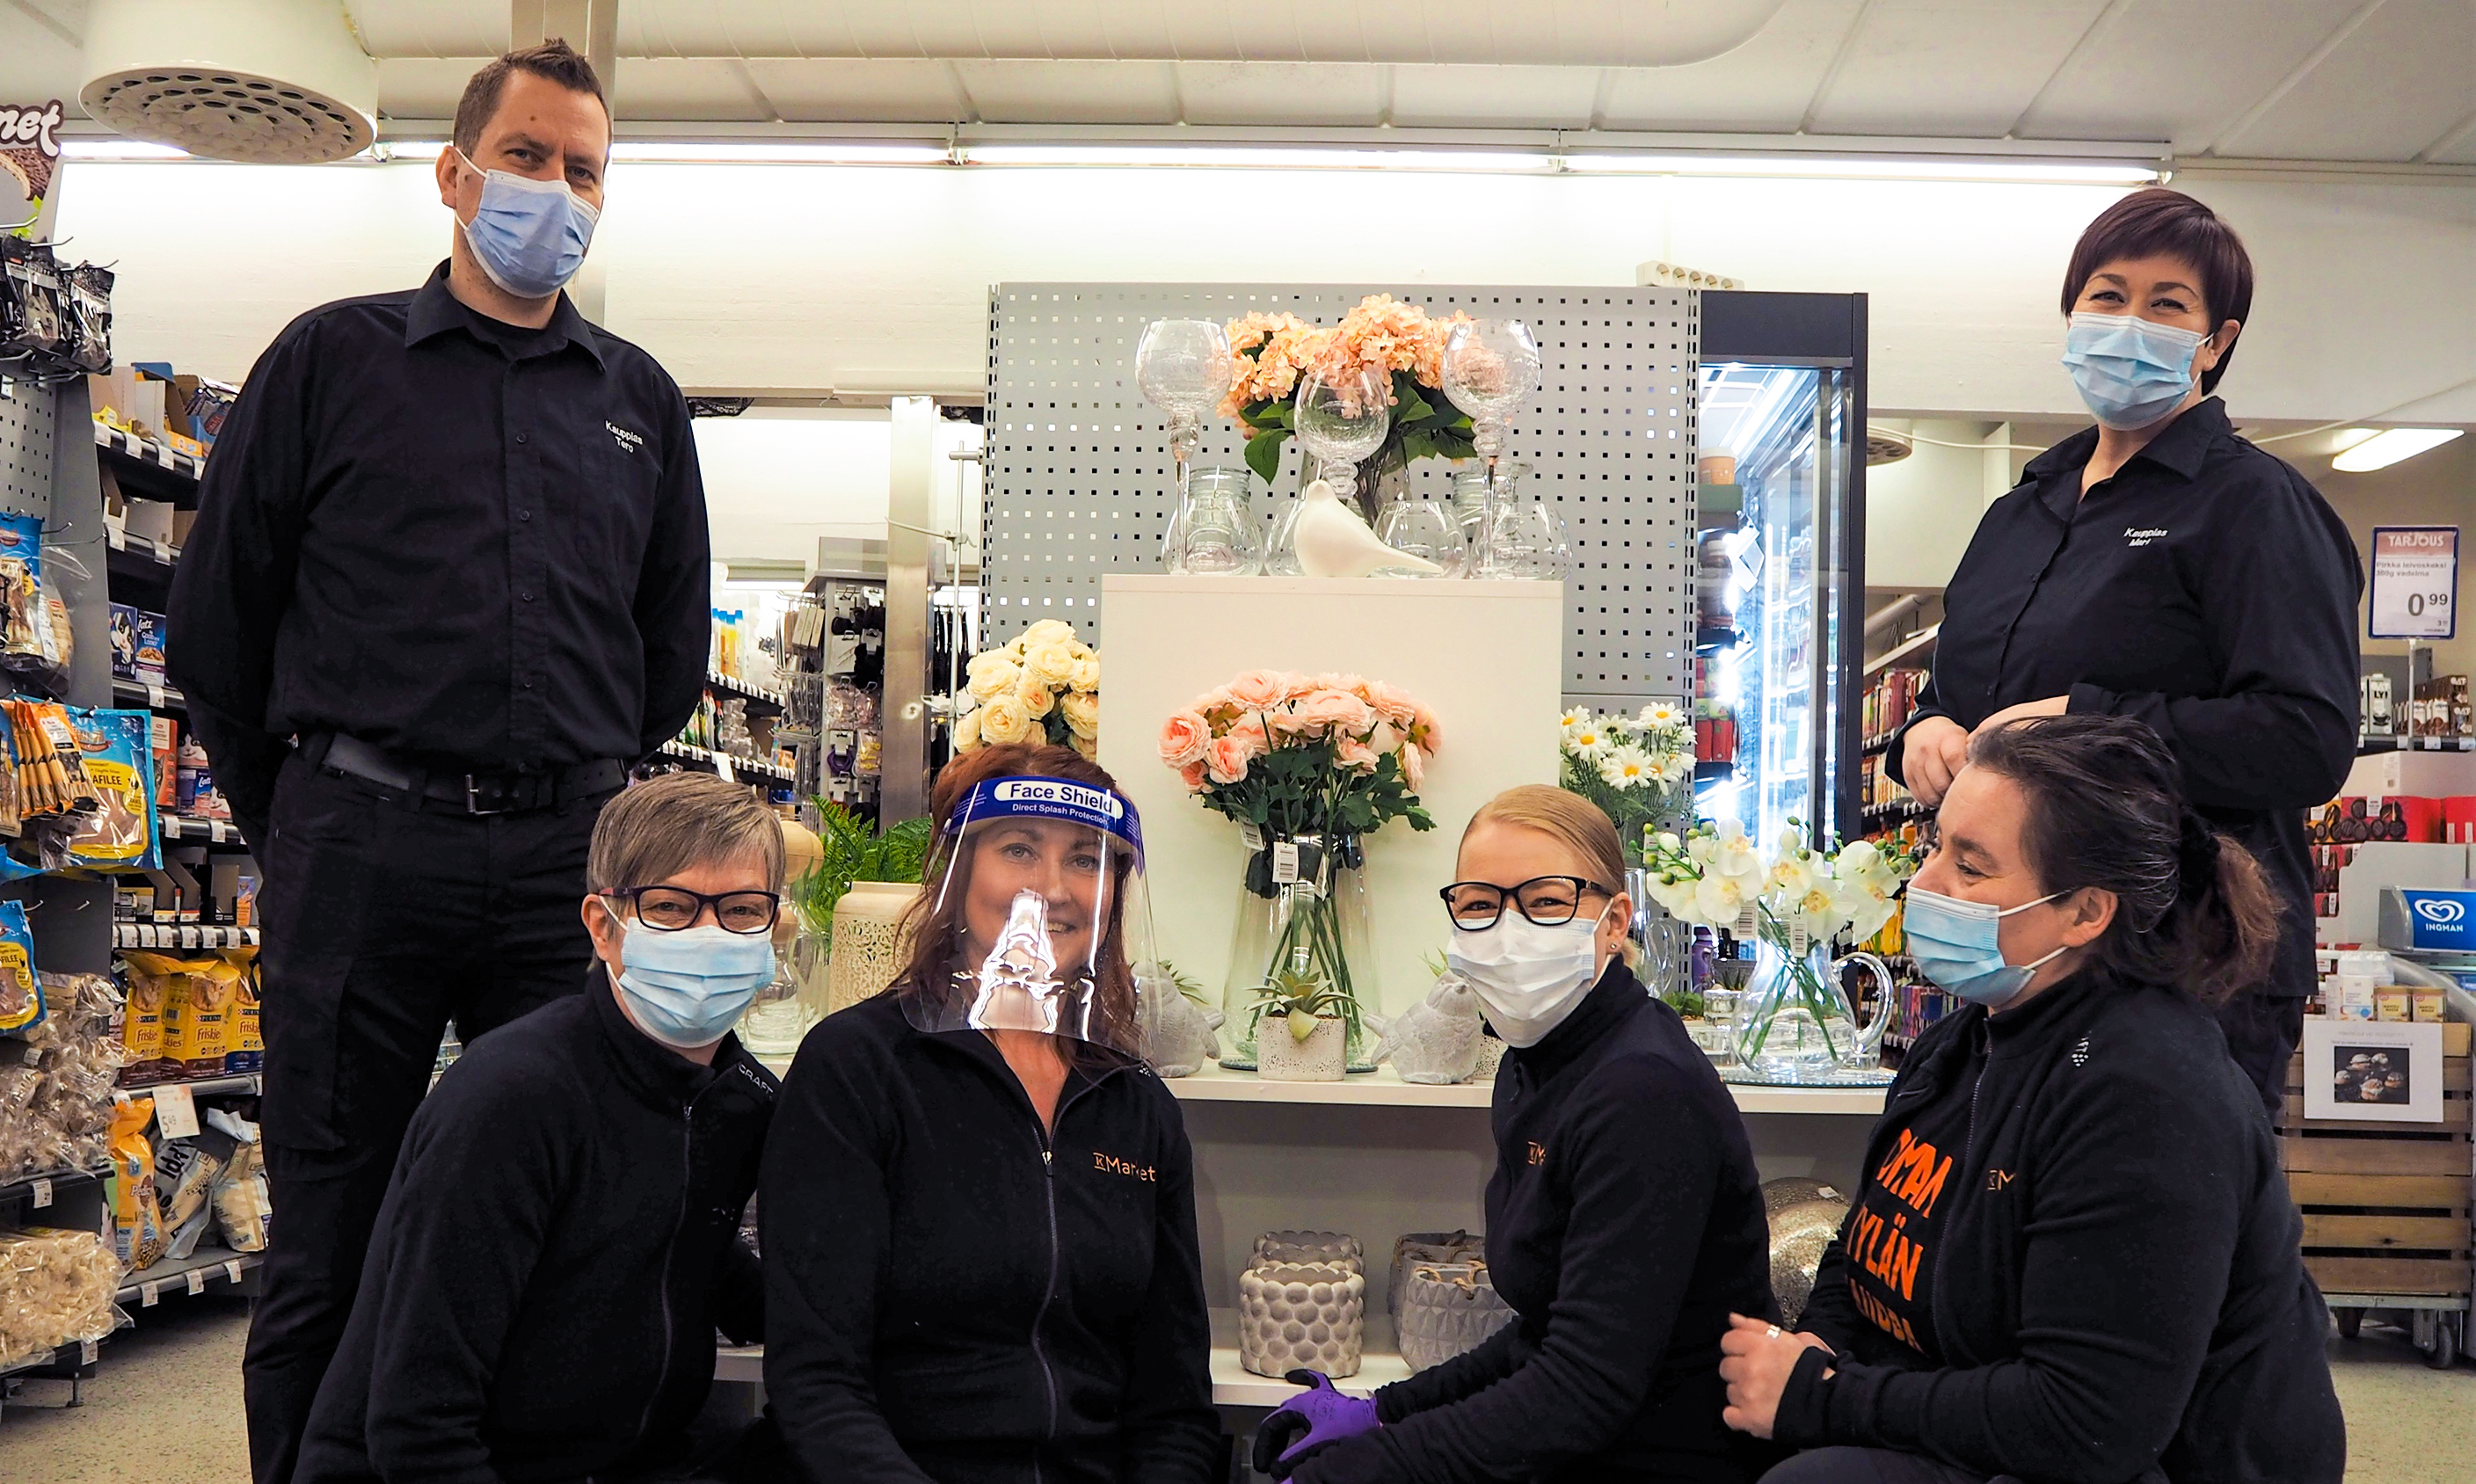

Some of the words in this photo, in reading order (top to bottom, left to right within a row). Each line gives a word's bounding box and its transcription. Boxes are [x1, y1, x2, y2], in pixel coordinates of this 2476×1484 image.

[605, 419, 644, 446] Kauppias
[615, 435, 634, 454] Tero
[2123, 527, 2168, 539] Kauppias
[2388, 532, 2444, 547] TARJOUS
[91, 775, 122, 785] AFILEE
[1009, 783, 1054, 799] Face
[1060, 787, 1113, 814] Shield
[1012, 804, 1038, 812] Direct
[1038, 804, 1068, 816] Splash
[1069, 808, 1110, 826] Protection
[2425, 922, 2464, 932] INGMAN
[739, 1064, 774, 1095] CRAFT
